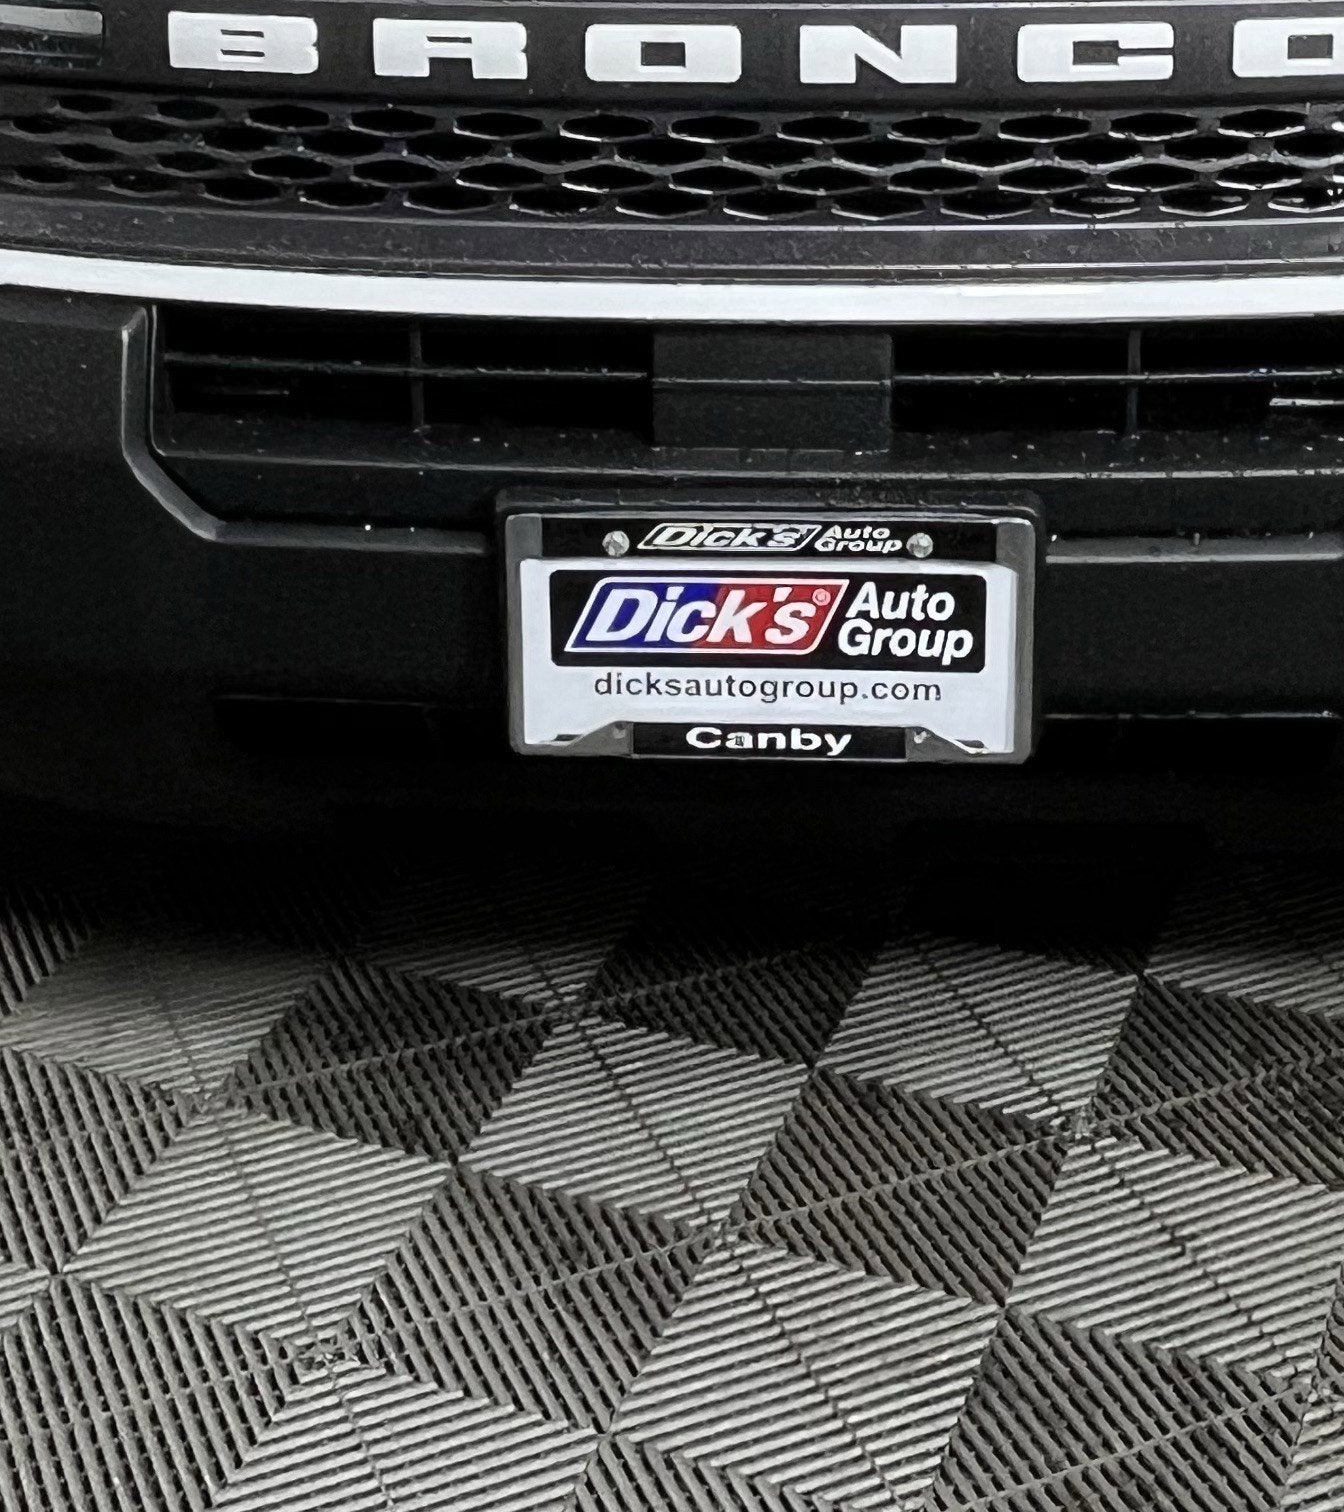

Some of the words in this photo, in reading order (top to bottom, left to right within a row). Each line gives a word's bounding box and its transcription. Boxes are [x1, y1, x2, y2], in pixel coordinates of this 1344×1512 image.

[651, 525, 806, 548] Dick's
[824, 525, 891, 539] Auto
[814, 538, 903, 554] Group
[585, 585, 815, 644] Dick's
[847, 582, 956, 622] Auto
[838, 621, 973, 665] Group
[594, 673, 942, 704] dicksautogroup.com
[685, 727, 852, 755] Canby
